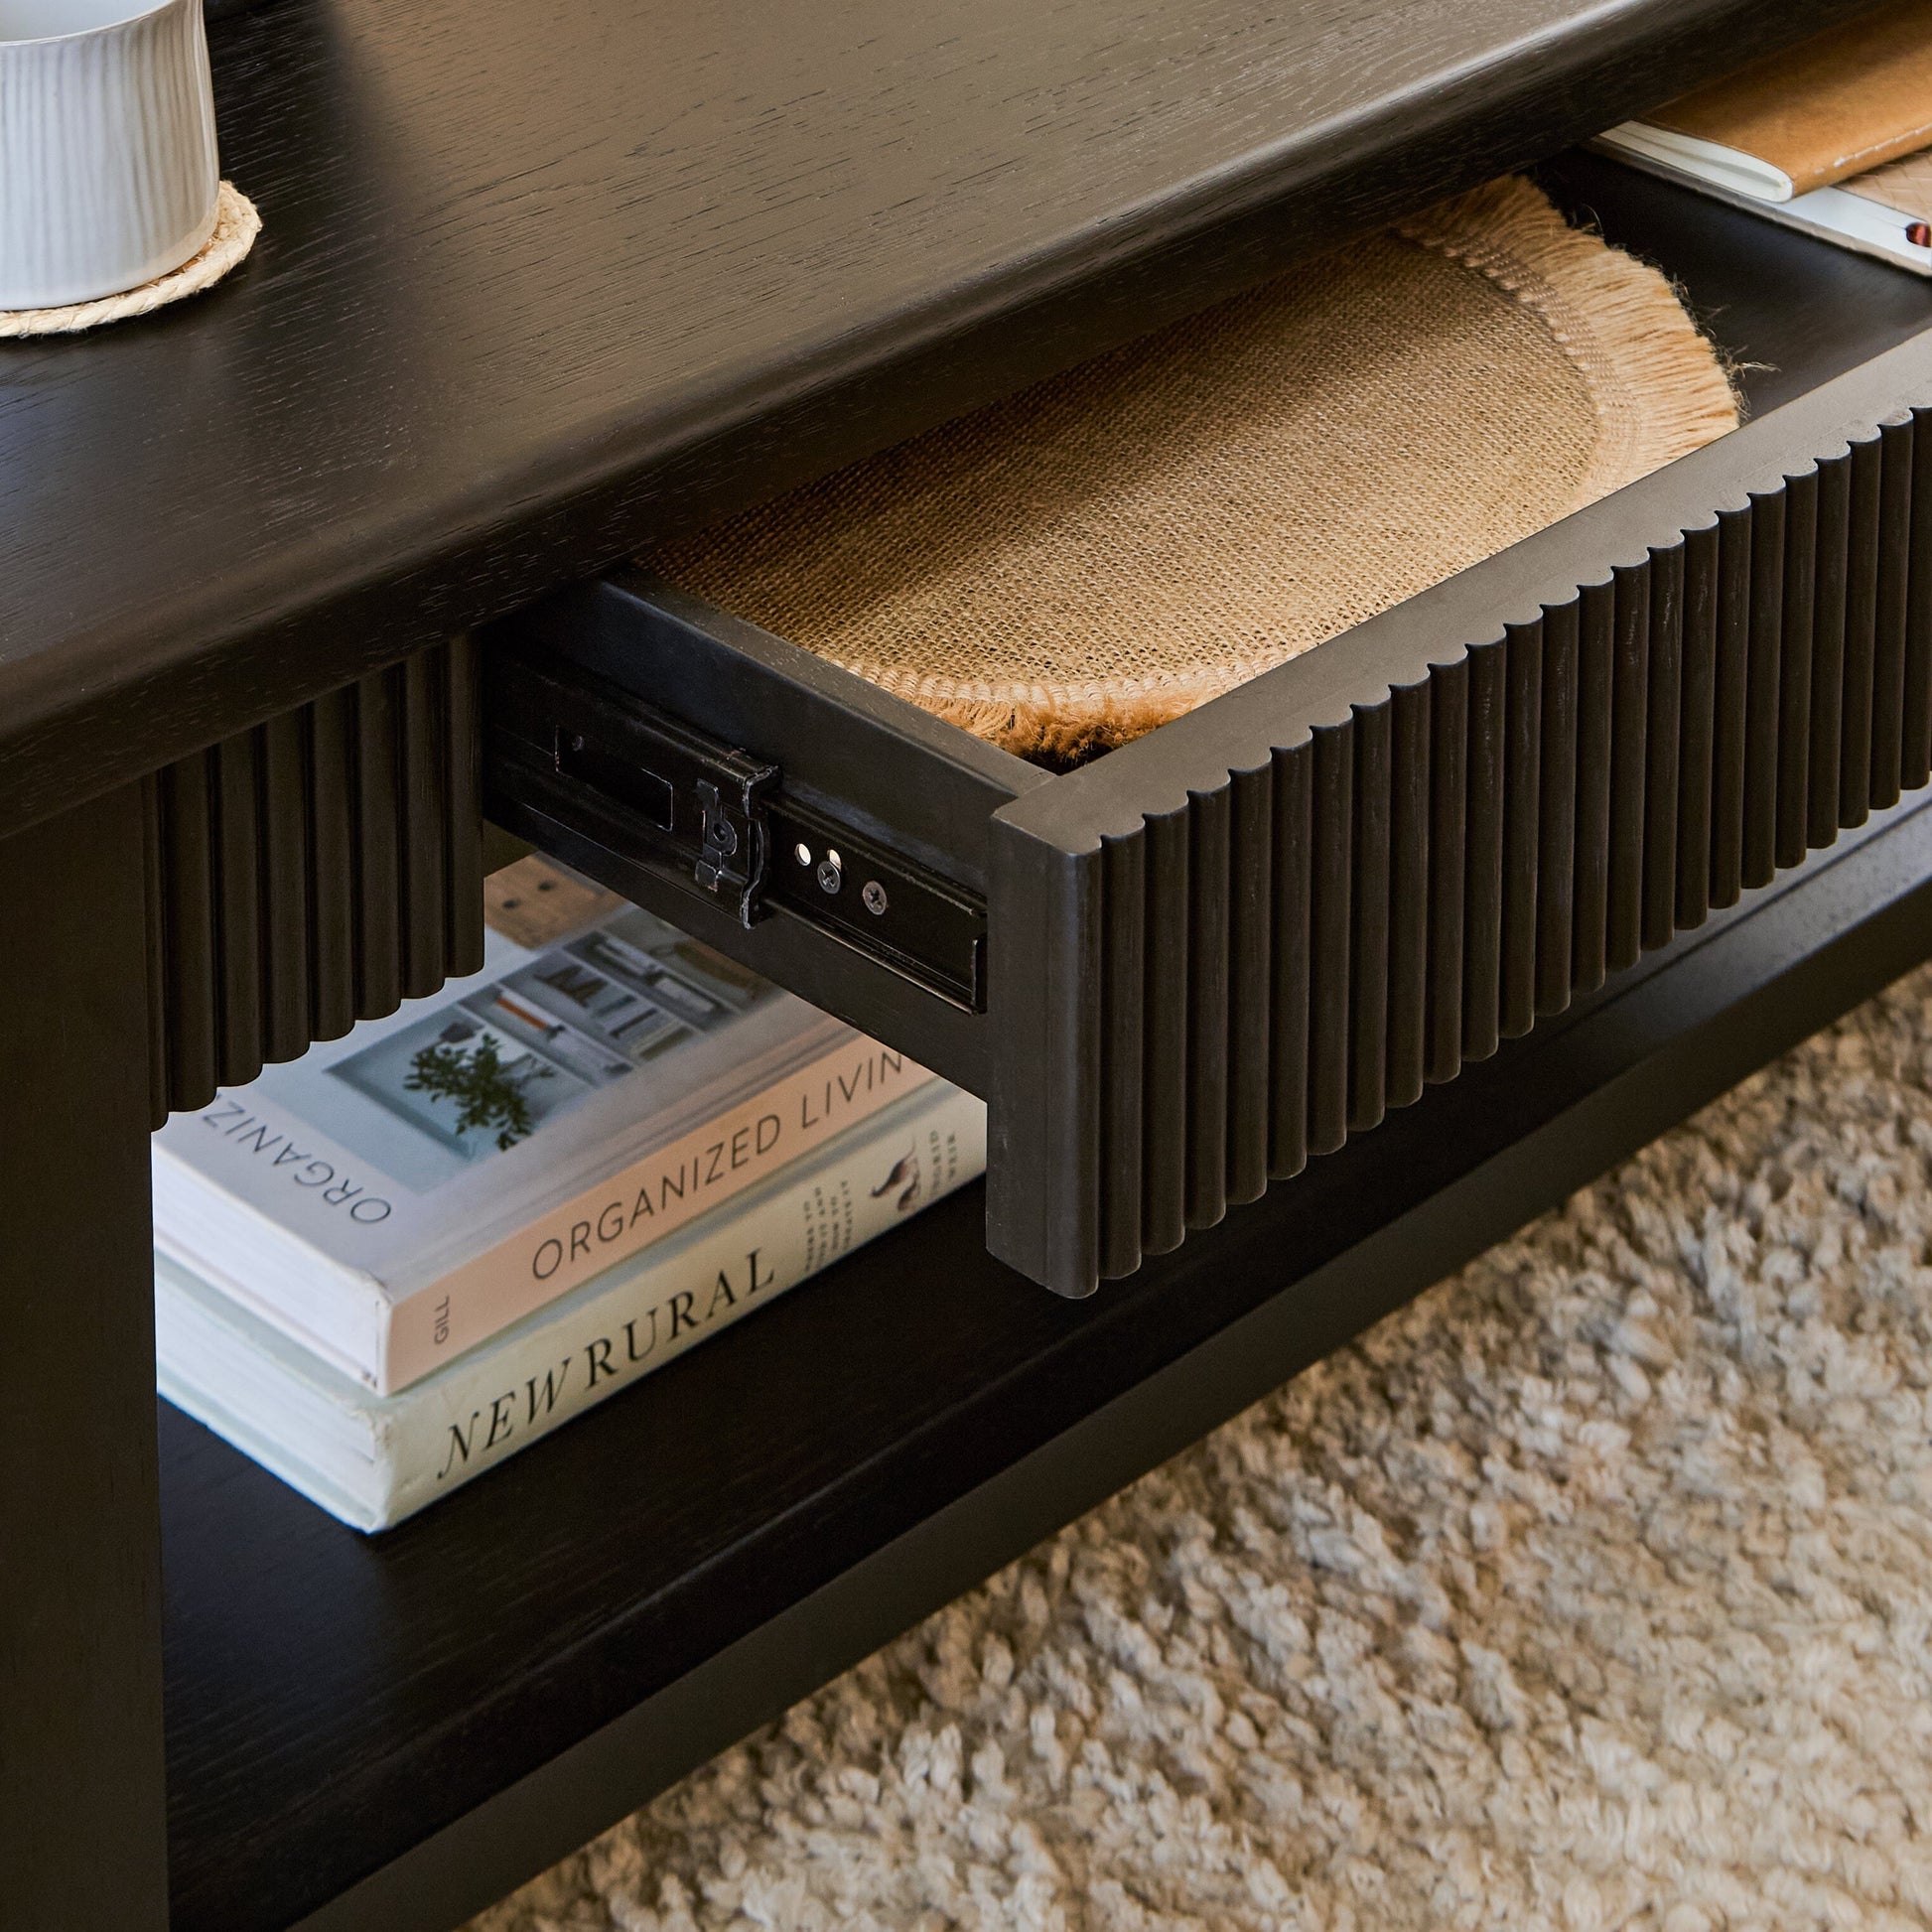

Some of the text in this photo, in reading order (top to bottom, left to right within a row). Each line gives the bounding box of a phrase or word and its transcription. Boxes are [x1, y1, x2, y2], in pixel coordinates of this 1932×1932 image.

[203, 1094, 391, 1224] ORGANIZ
[532, 1114, 781, 1280] ORGANIZED
[801, 1051, 901, 1129] LIVIN
[434, 1295, 451, 1344] GILL
[437, 1247, 774, 1479] NEW RURAL
